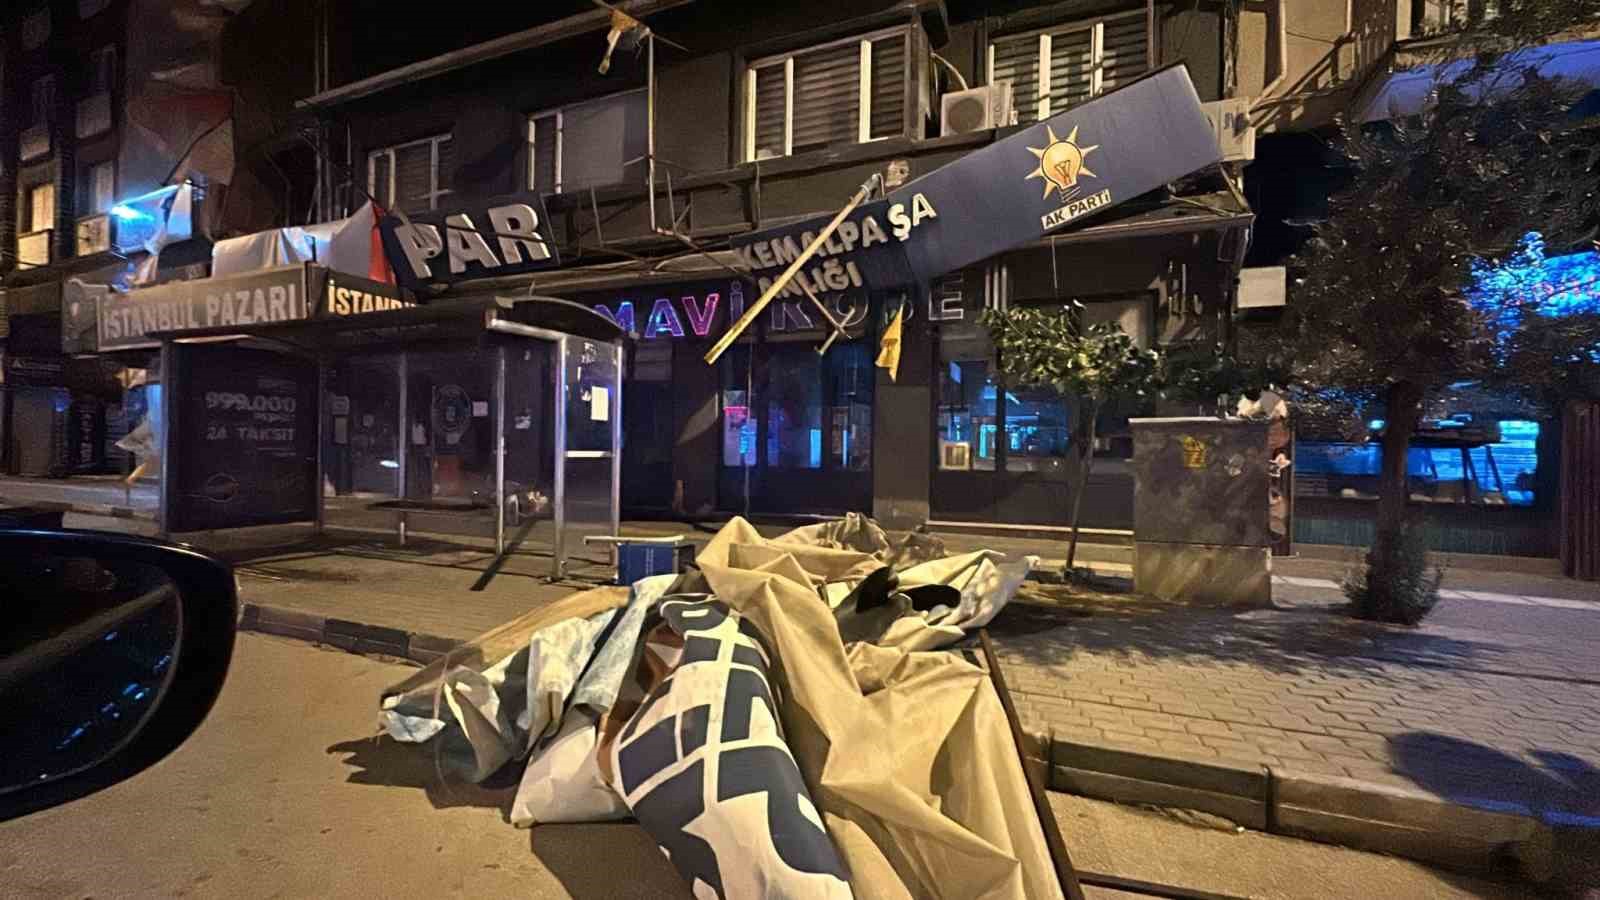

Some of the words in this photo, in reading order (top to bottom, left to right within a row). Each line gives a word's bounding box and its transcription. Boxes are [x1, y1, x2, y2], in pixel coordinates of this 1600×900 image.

[1045, 210, 1065, 227] AK
[394, 203, 551, 279] PAR
[207, 284, 297, 327] PAZARI
